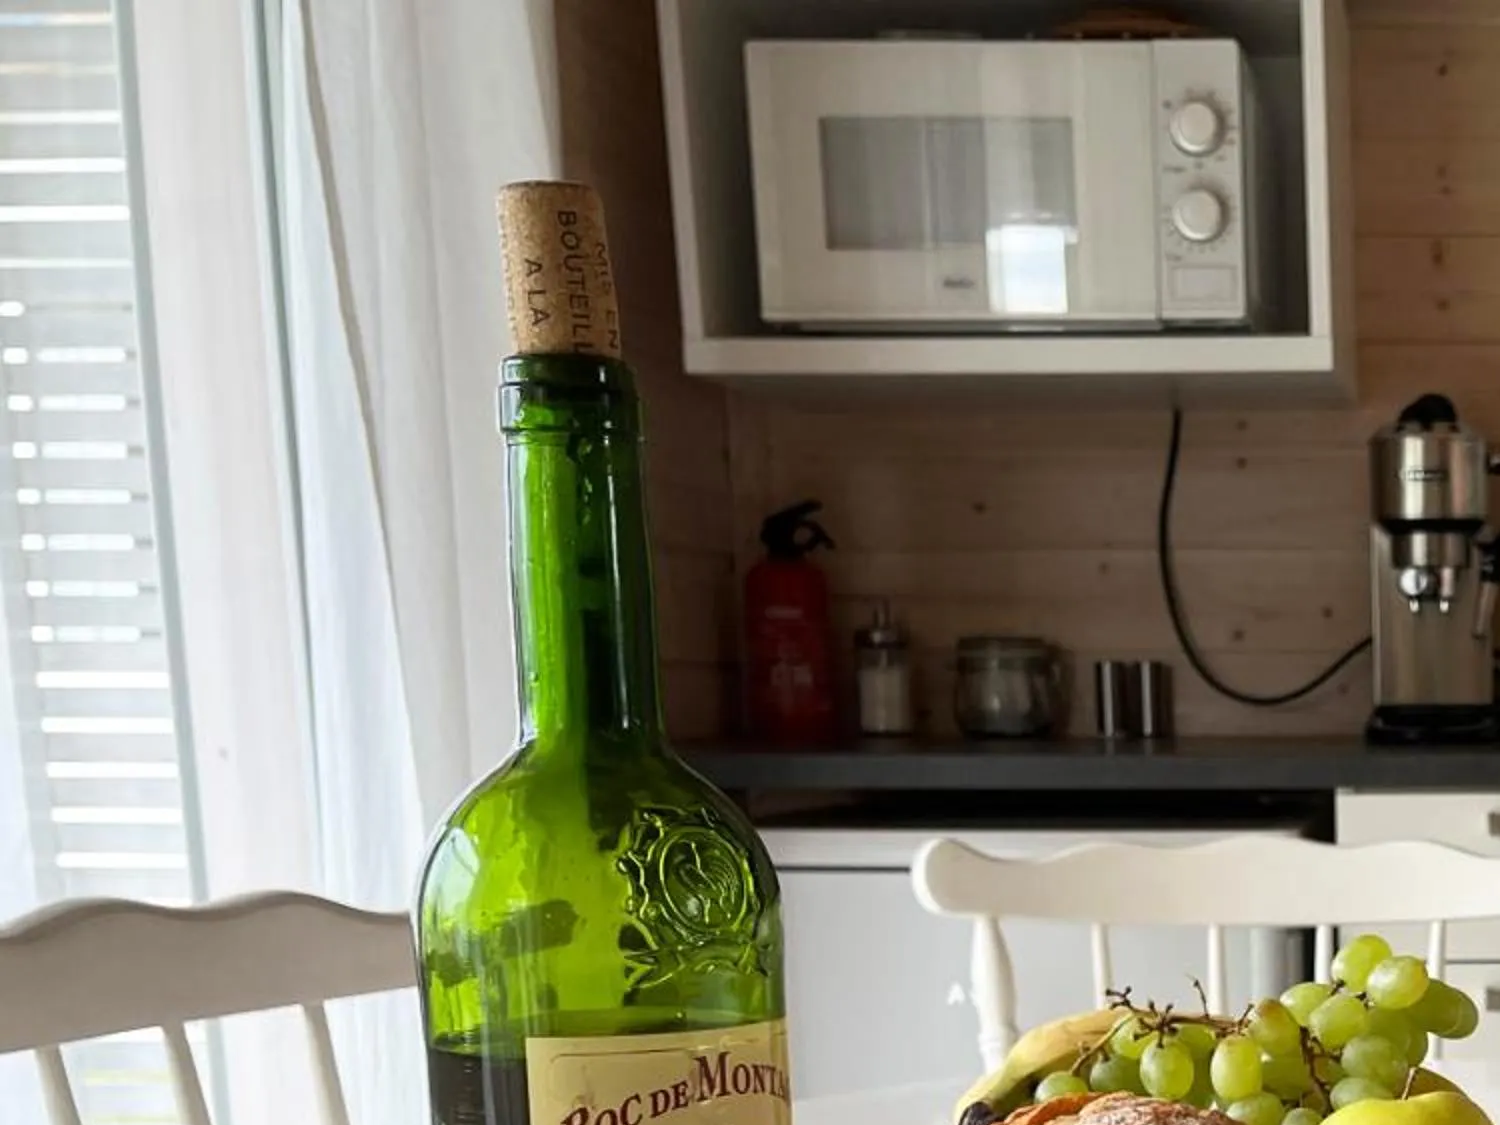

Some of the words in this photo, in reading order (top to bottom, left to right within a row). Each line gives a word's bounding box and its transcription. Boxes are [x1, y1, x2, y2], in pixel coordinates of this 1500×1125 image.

[557, 210, 594, 354] BOUTEILL
[527, 290, 550, 326] LA
[650, 1080, 690, 1118] DE
